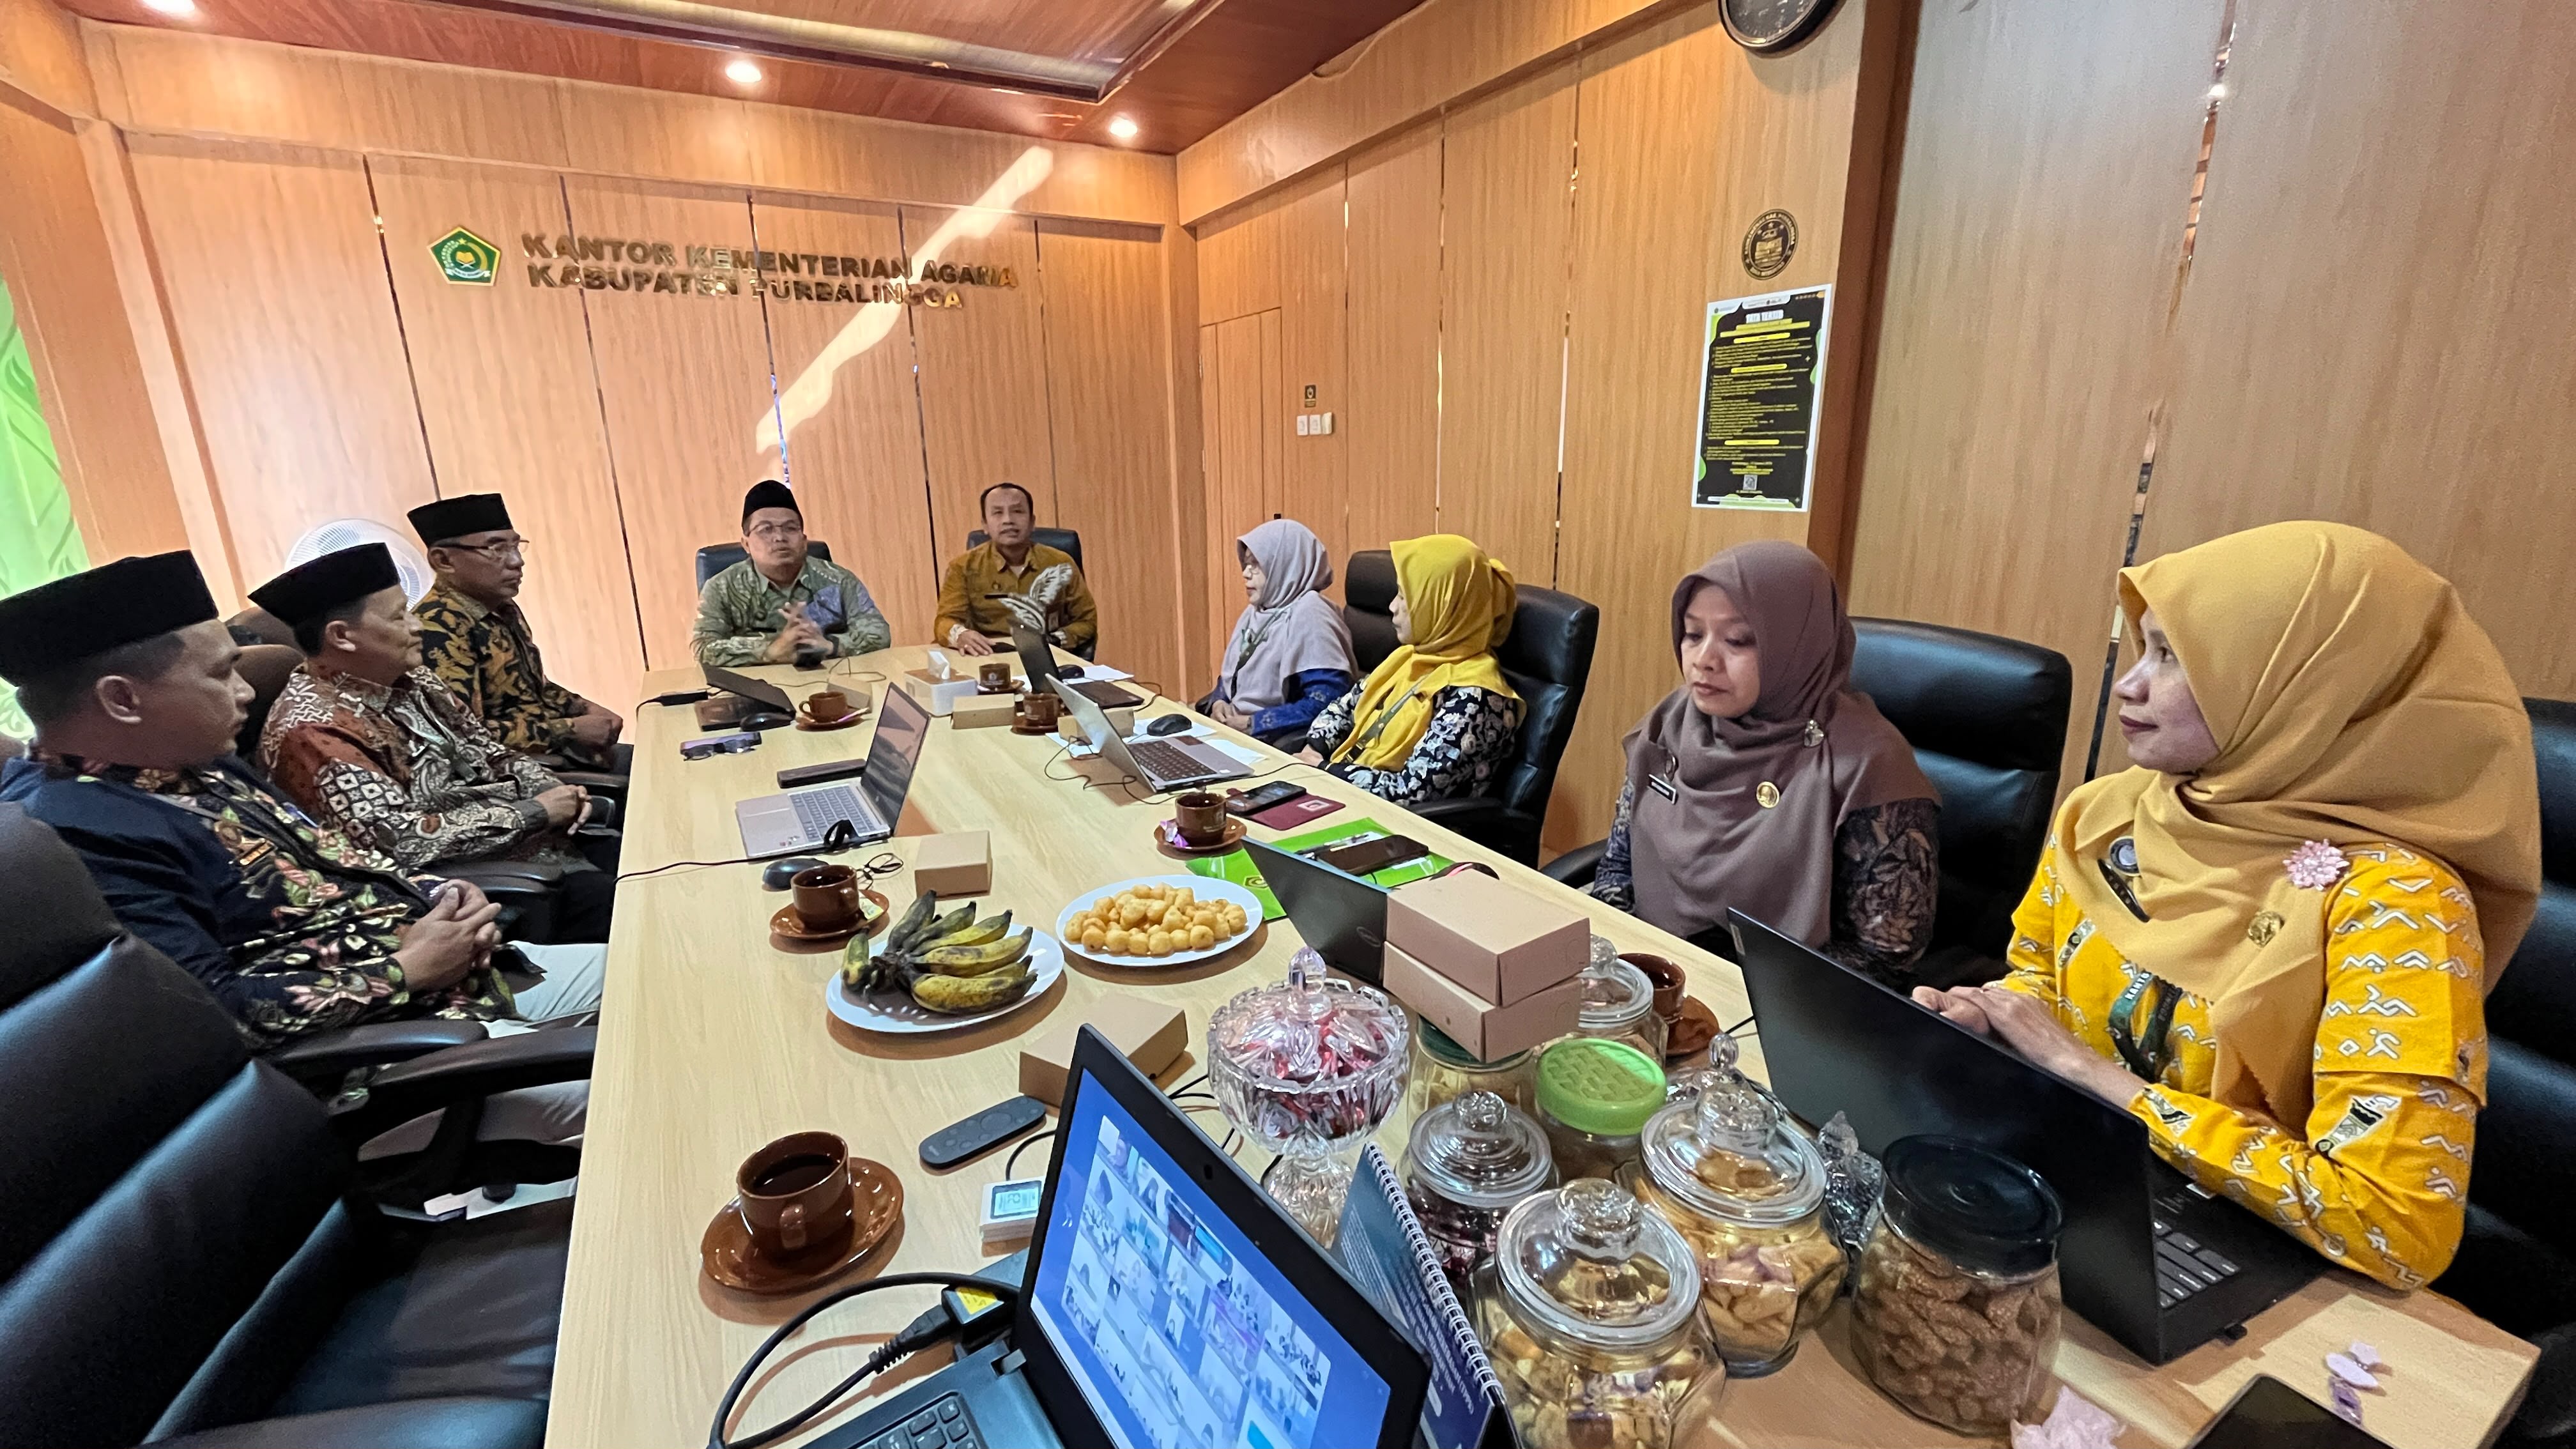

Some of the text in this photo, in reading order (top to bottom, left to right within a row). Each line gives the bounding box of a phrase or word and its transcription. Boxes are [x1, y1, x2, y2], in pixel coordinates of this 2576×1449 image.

[521, 233, 1019, 289] KANTOR KEMENTERIAN AGAMA
[527, 263, 739, 297] KABUPATEN
